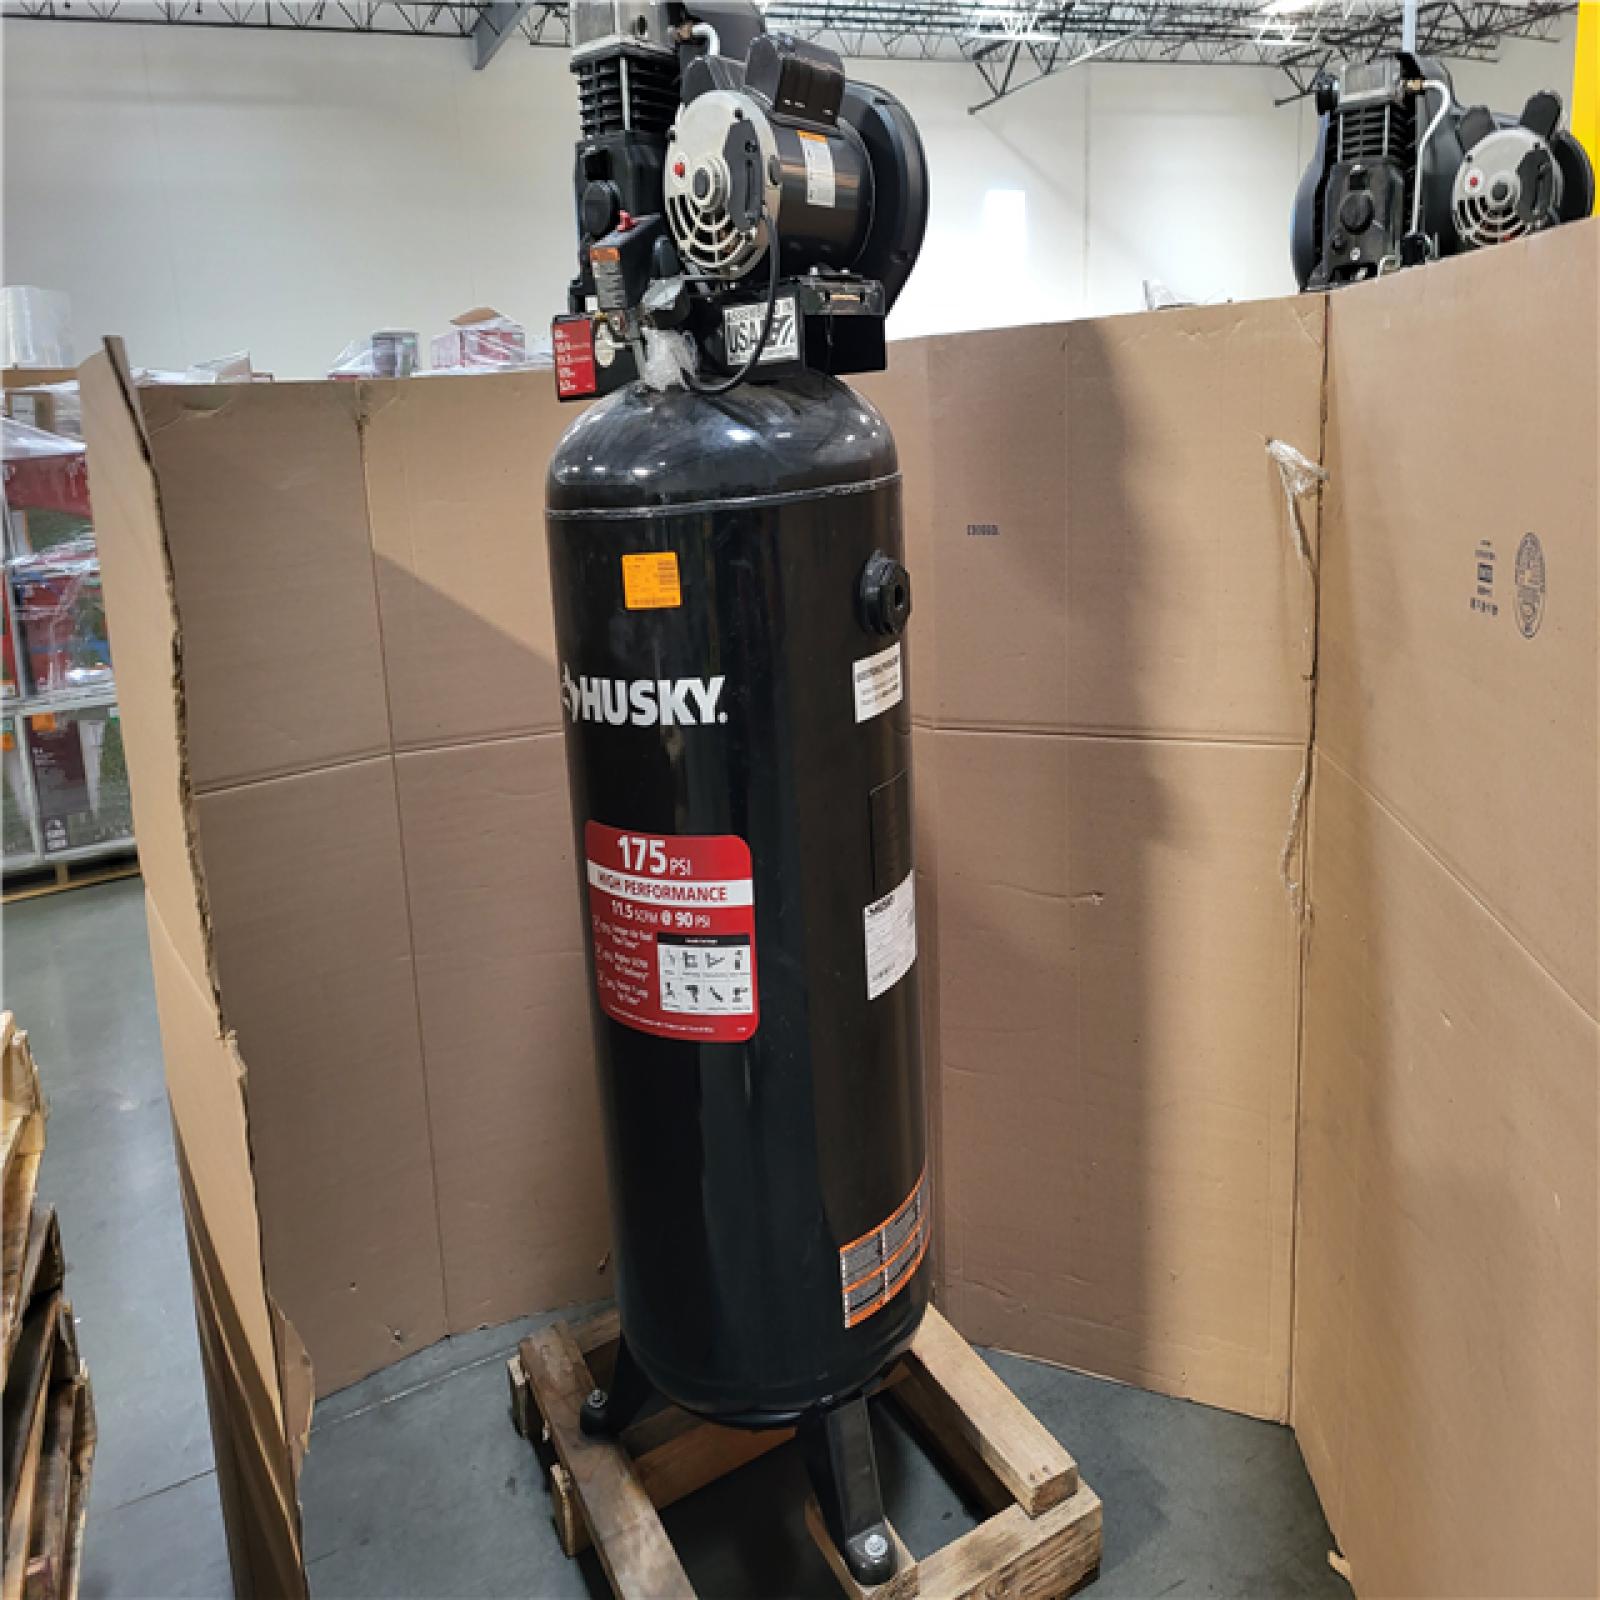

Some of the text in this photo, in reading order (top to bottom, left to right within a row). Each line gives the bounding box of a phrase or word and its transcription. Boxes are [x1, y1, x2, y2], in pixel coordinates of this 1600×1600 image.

[618, 836, 691, 876] 175 PSI
[624, 879, 729, 902] PERFORMANCE
[674, 911, 694, 928] 90
[695, 914, 711, 929] PSI
